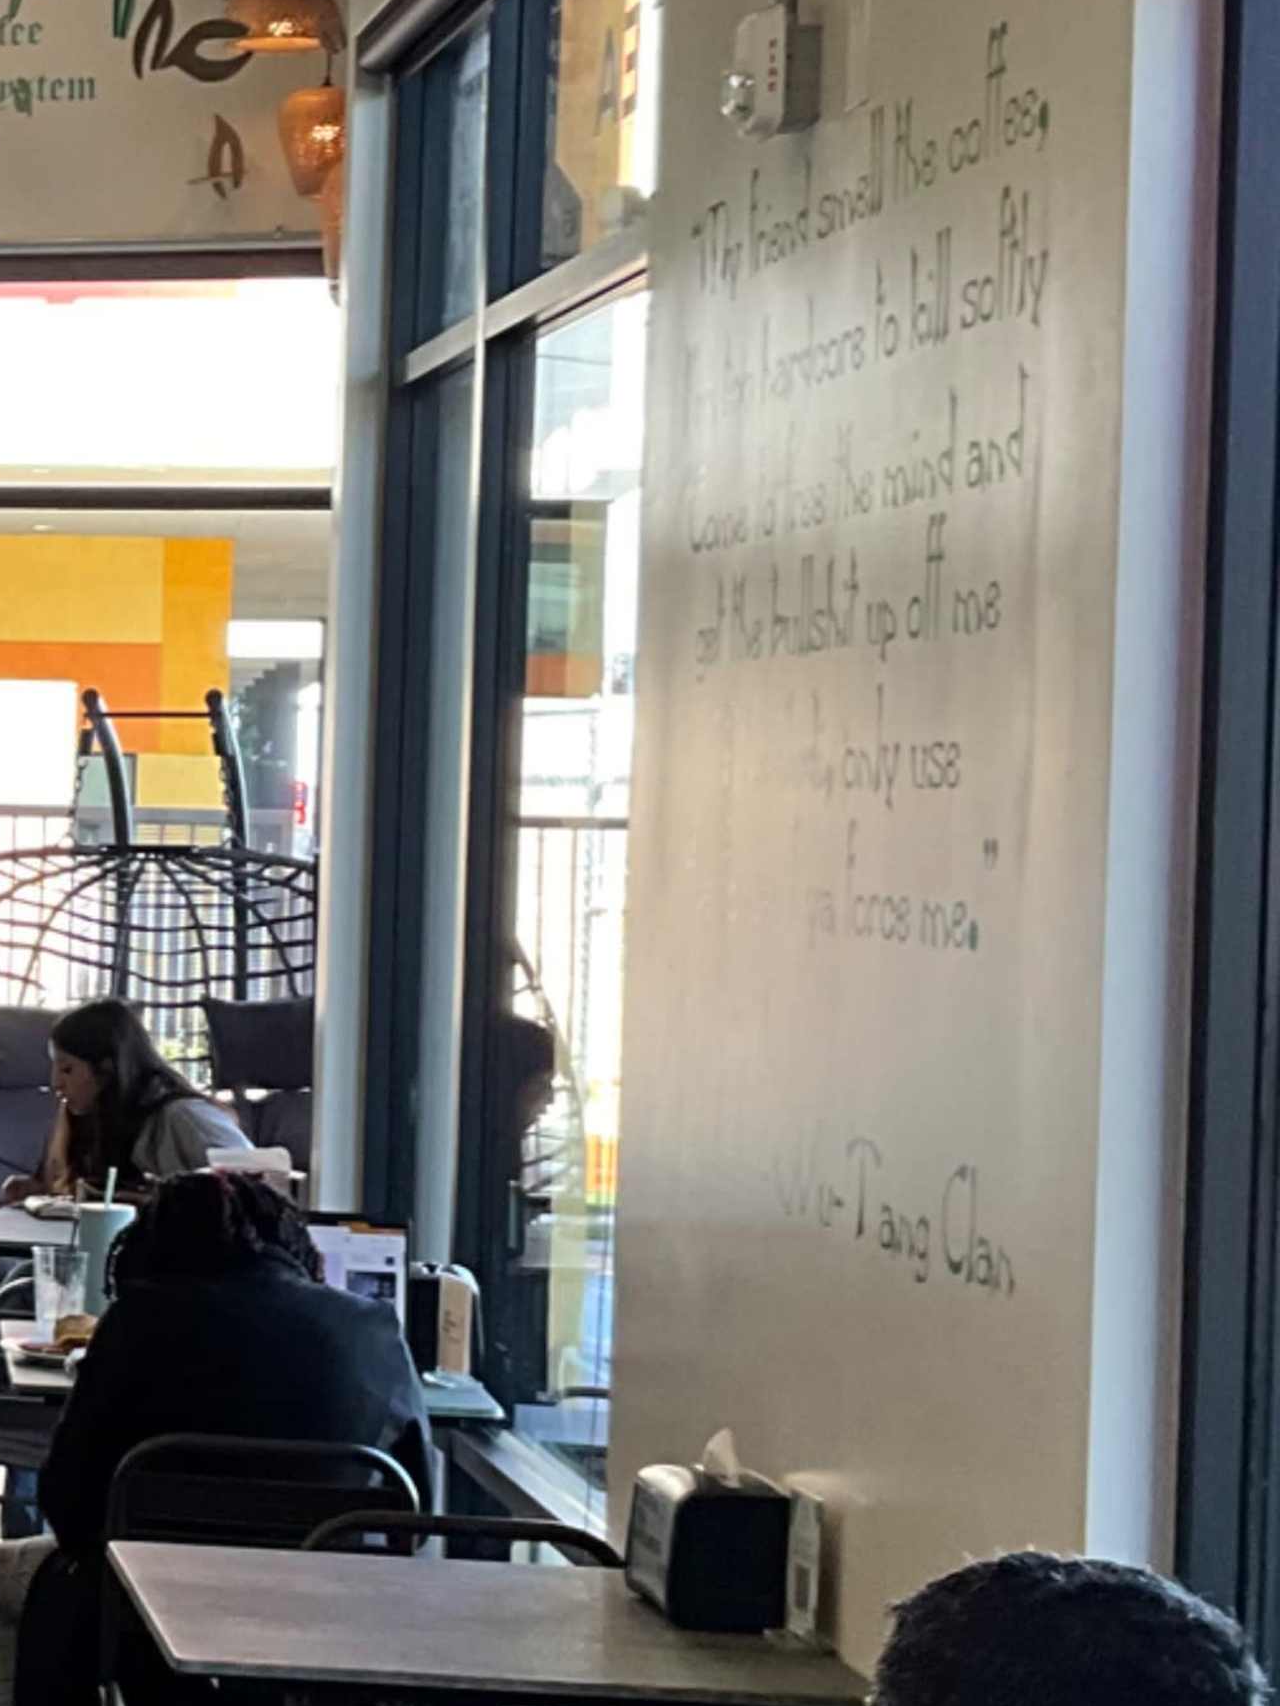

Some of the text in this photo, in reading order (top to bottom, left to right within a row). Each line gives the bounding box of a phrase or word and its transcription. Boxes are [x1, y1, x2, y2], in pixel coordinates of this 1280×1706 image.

[873, 259, 900, 362] to
[910, 227, 952, 351] kill
[961, 185, 1049, 329] softly
[882, 386, 958, 508] mind
[967, 360, 1031, 490] and
[866, 599, 897, 663] up
[906, 511, 948, 641] off
[952, 580, 1002, 635] me
[911, 741, 961, 790] use
[942, 1163, 1016, 1298] Clan
